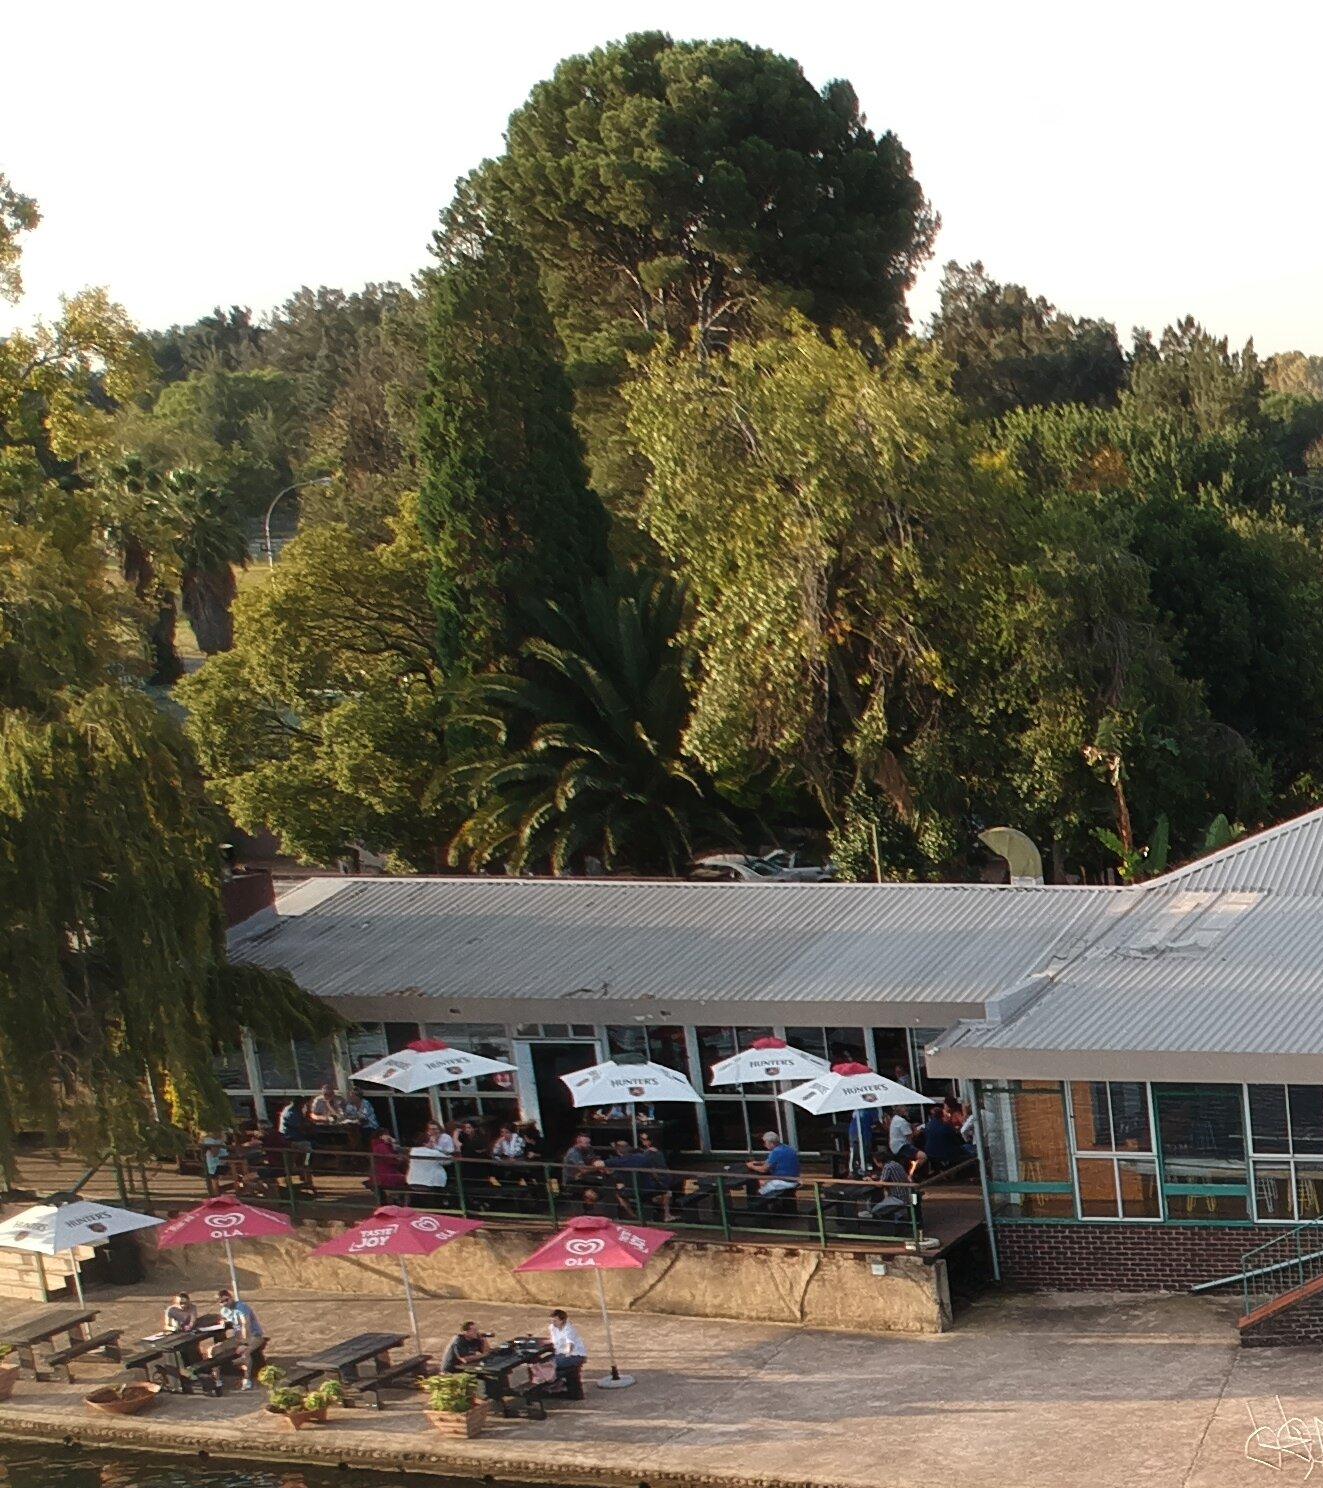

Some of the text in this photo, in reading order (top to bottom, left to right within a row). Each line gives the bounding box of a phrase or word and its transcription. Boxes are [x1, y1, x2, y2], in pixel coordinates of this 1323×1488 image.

[210, 1229, 244, 1239] OLA
[357, 1236, 390, 1248] JOY
[564, 1257, 596, 1267] OLA
